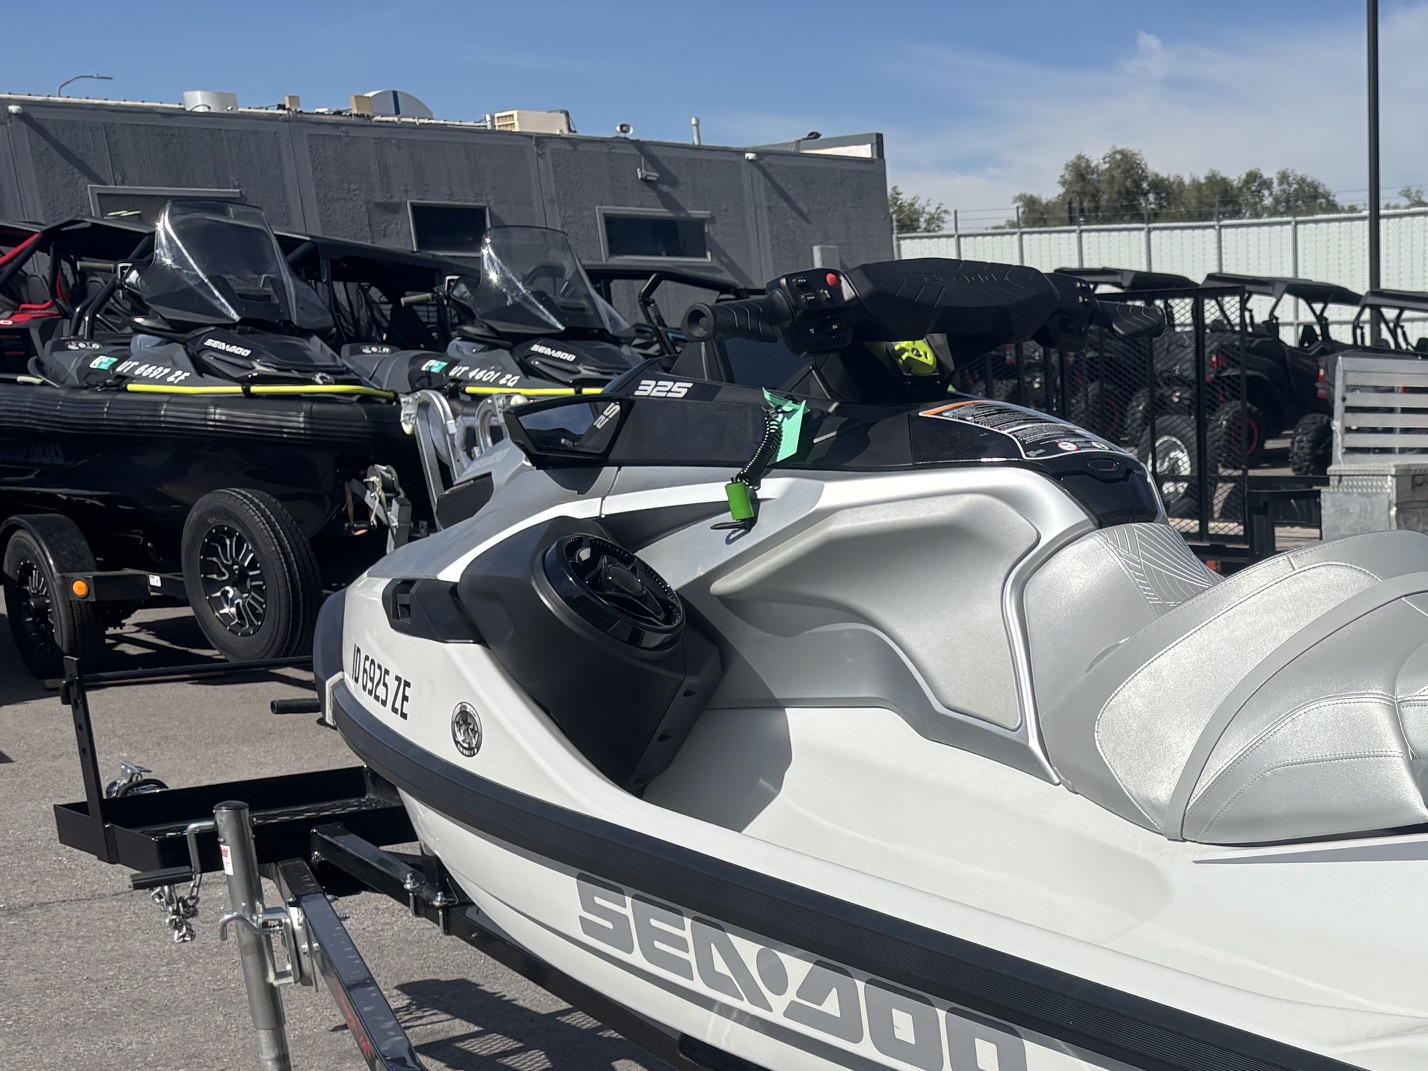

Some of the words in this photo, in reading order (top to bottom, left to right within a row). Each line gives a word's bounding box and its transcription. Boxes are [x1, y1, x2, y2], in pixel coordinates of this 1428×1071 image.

[115, 360, 140, 374] UT
[448, 365, 470, 378] UT
[633, 379, 694, 398] 325
[352, 643, 361, 685] ID
[362, 654, 390, 708] 6925
[391, 674, 412, 721] ZE
